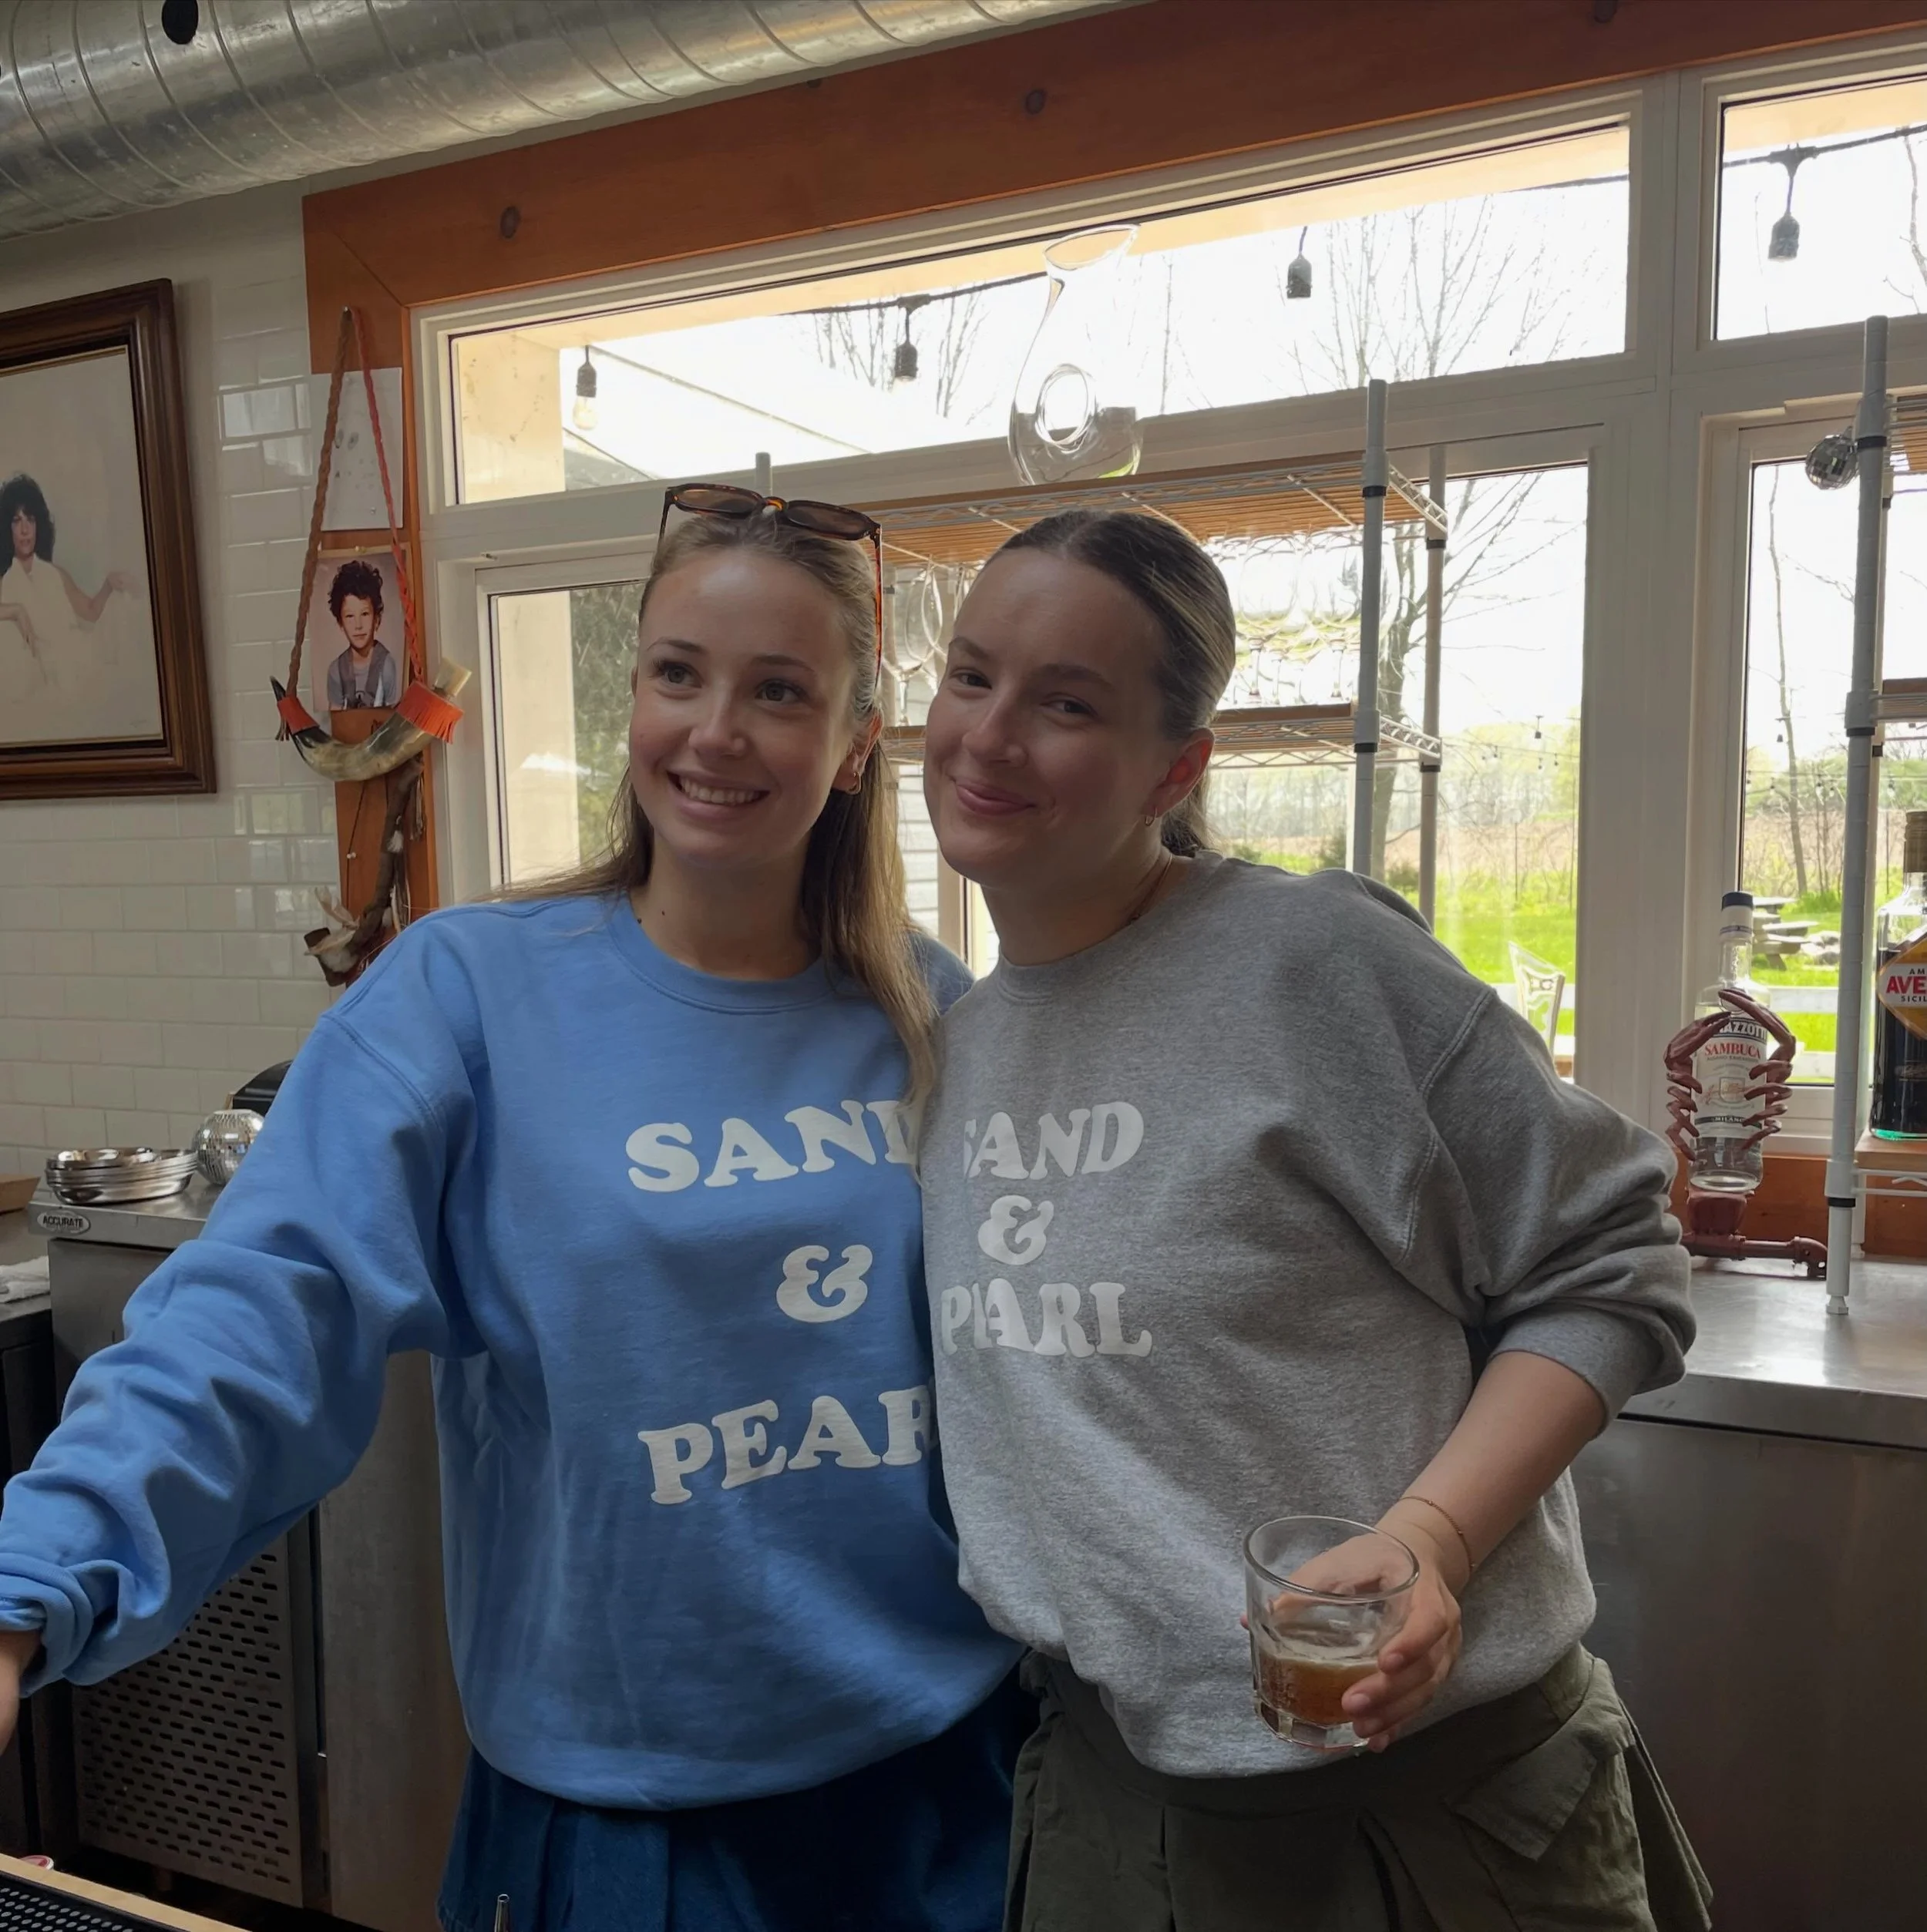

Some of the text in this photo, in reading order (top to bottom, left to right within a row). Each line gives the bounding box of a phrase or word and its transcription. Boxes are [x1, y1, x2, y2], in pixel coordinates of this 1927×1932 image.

[1886, 976, 1927, 994] AVE
[1704, 1043, 1761, 1059] SAMBUCA
[43, 1215, 83, 1228] ACCURATE
[978, 1194, 1054, 1265] &
[775, 1244, 873, 1323] &
